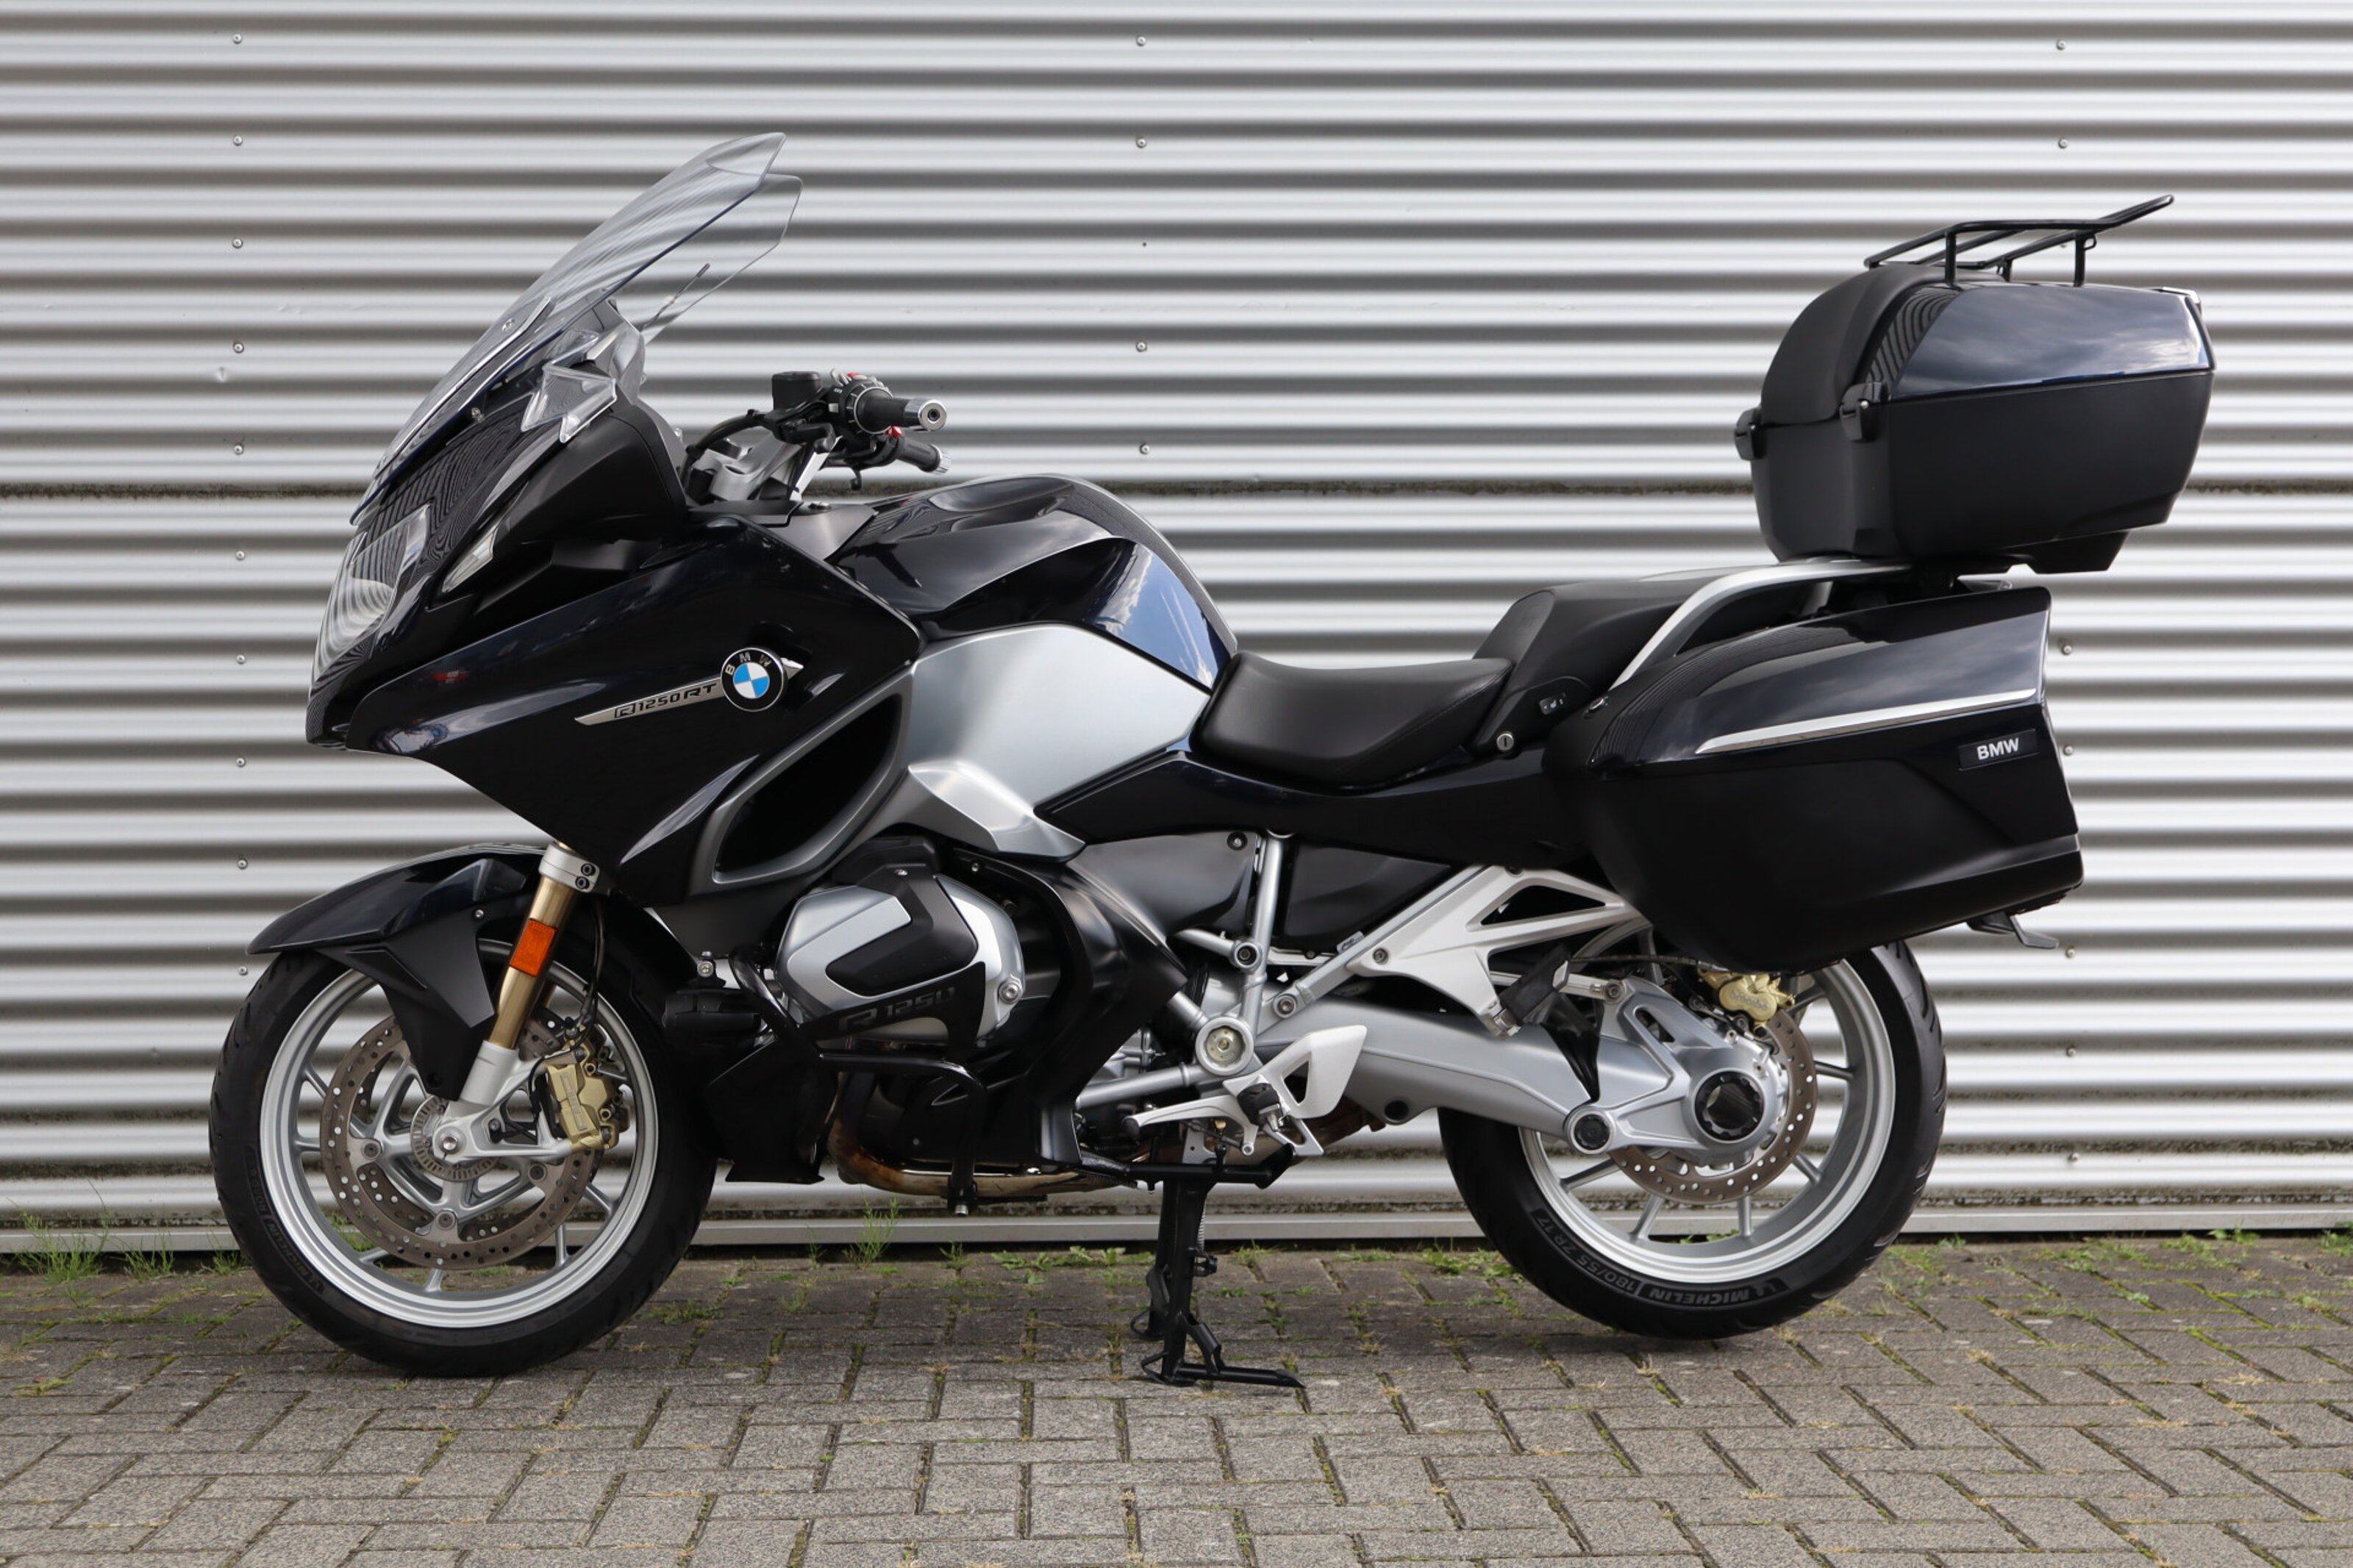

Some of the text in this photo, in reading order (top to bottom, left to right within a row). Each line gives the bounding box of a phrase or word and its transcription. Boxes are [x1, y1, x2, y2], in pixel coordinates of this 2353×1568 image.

[725, 651, 771, 676] BMW
[1977, 737, 2019, 760] BMW
[266, 1223, 309, 1276] MICHELIN
[1577, 1254, 1638, 1292] 180/55
[1649, 1287, 1749, 1305] MICHELIN
